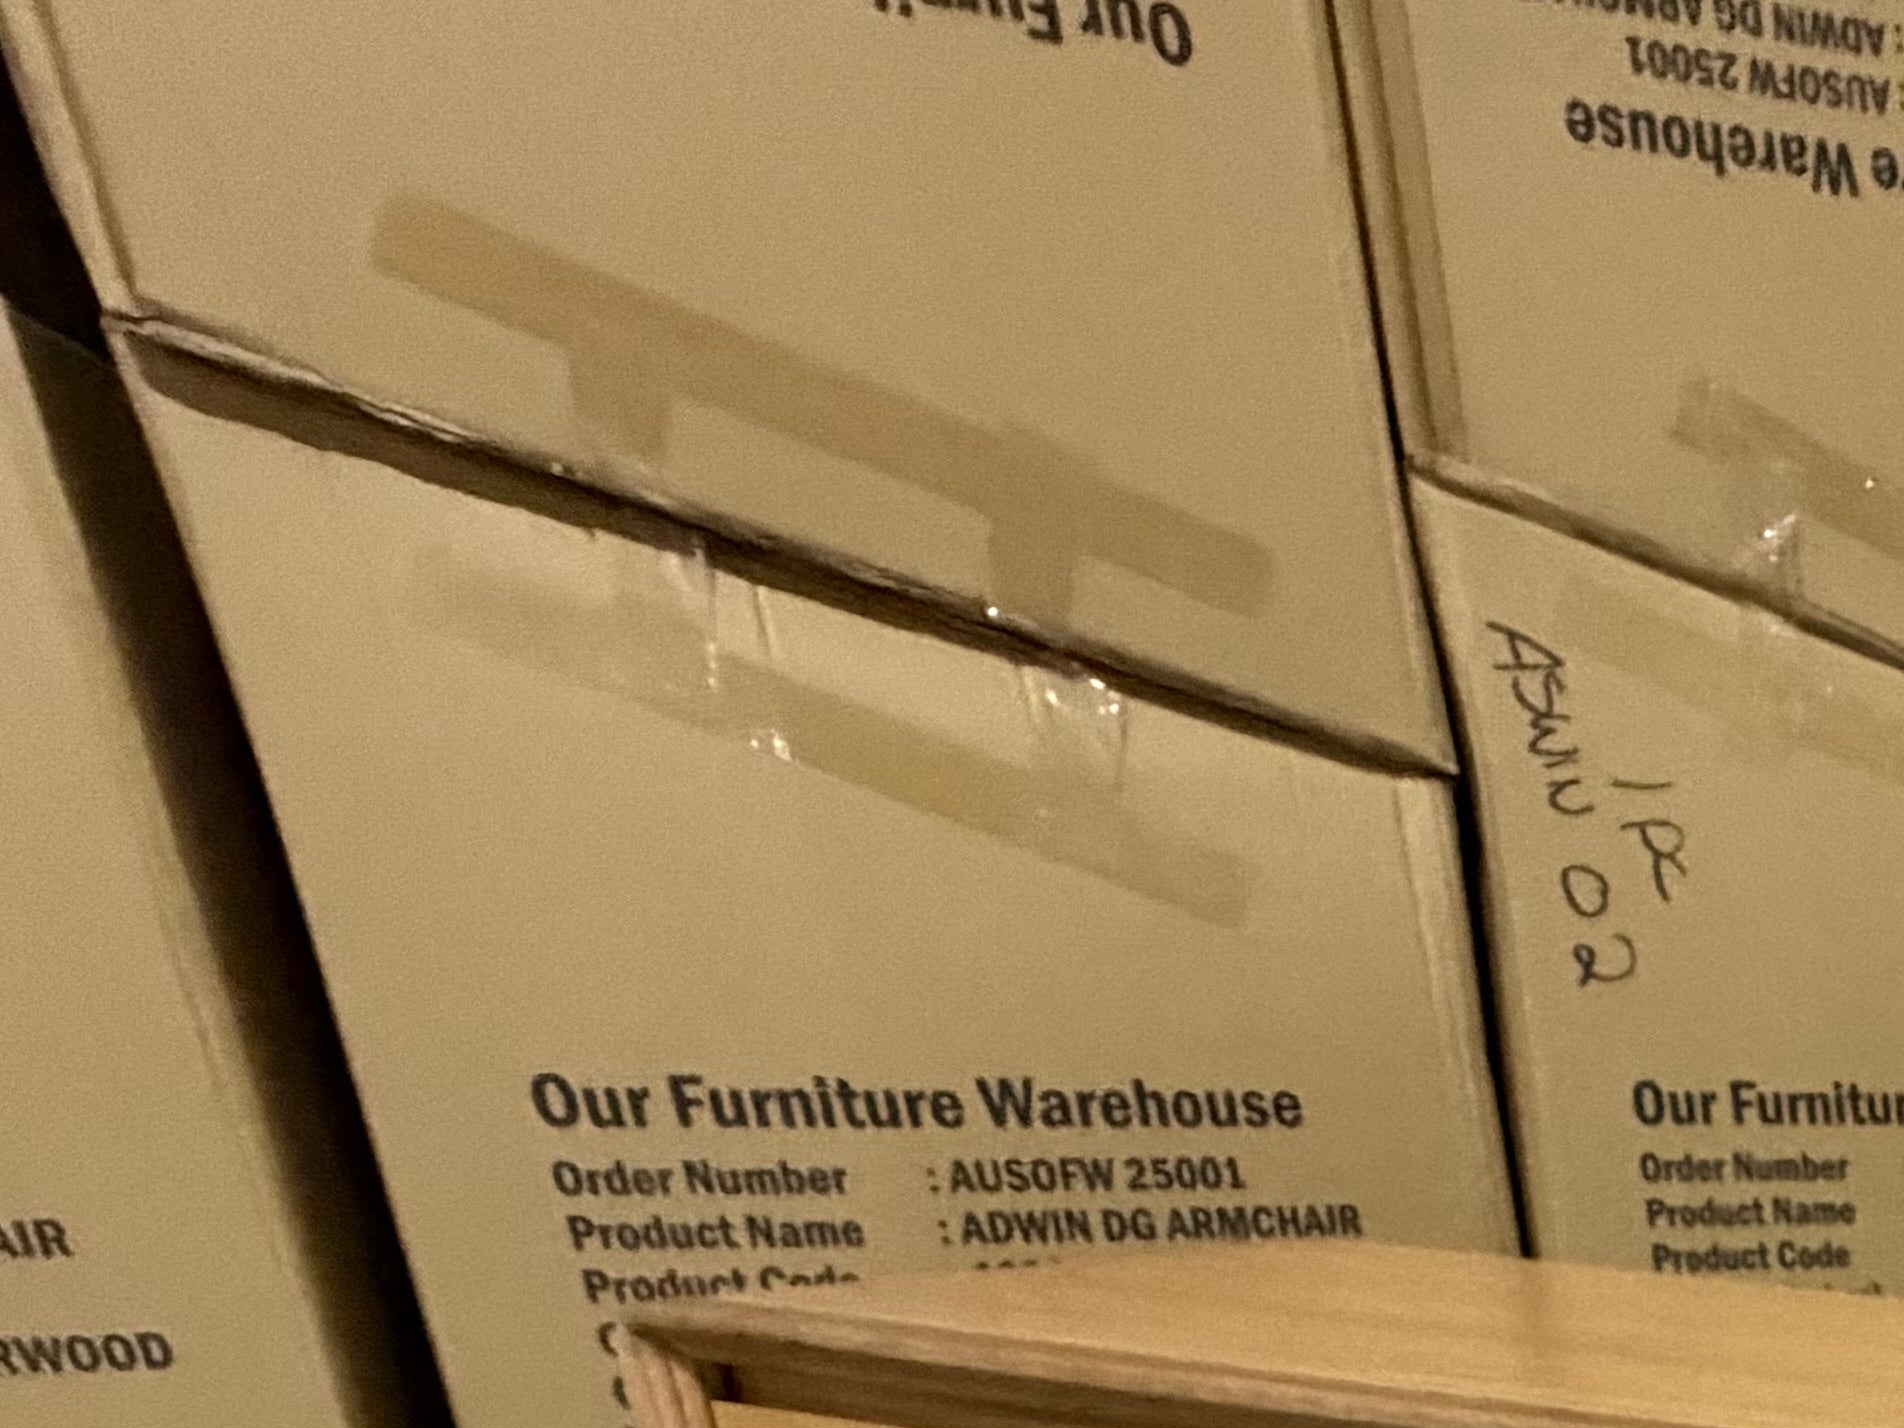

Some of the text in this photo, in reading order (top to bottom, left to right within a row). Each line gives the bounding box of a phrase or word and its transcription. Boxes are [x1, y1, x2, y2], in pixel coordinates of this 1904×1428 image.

[1080, 0, 1192, 66] Our
[1713, 0, 1762, 37] DG
[1773, 2, 1884, 57] ADWIN
[1625, 36, 1738, 90] 25001
[1749, 56, 1890, 115] AUSOFW
[1565, 97, 1859, 197] Warehouse
[530, 1072, 1304, 1130] Our Furniture Warehouse
[1632, 1079, 1717, 1126] Our
[552, 1159, 674, 1197] Order
[682, 1159, 847, 1197] Number
[949, 1156, 1115, 1194] AUSOFW
[1124, 1155, 1246, 1191] 25001
[1640, 1152, 1726, 1183] Order
[1732, 1153, 1849, 1182] Number
[565, 1213, 740, 1252] Product
[743, 1214, 865, 1249] Name
[961, 1208, 1093, 1245] ADWIN
[1103, 1208, 1157, 1242] DG
[1167, 1203, 1364, 1242] ARMCHAIR
[1645, 1198, 1764, 1227] Product
[1772, 1198, 1856, 1225] Name
[1651, 1242, 1770, 1274] Product
[1778, 1241, 1850, 1269] Code
[582, 1267, 747, 1304] Product
